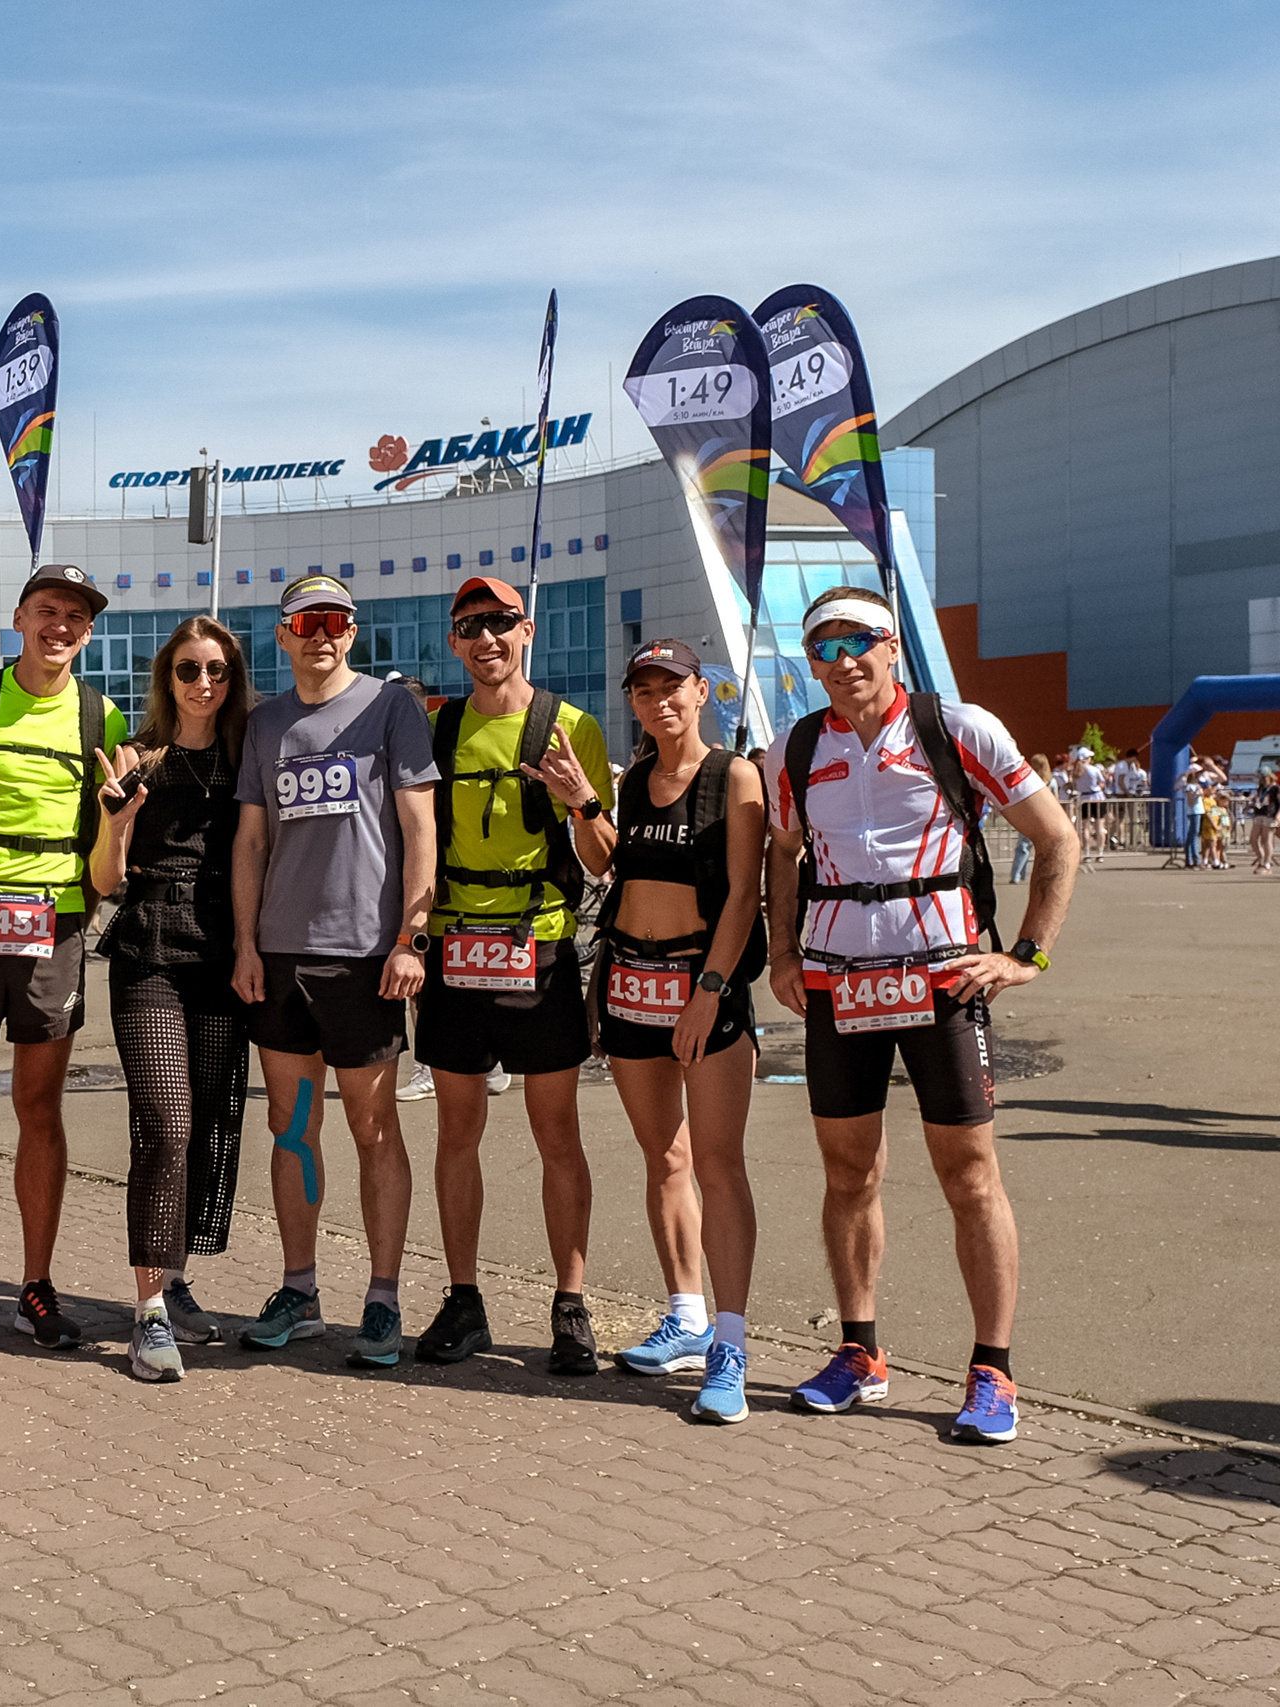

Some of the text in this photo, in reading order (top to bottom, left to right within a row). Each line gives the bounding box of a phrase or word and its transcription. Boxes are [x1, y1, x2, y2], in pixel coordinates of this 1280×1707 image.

[664, 319, 709, 338] Быстрее
[770, 327, 801, 349] Ветра
[682, 336, 715, 355] Ветра
[6, 353, 40, 393] 1:39
[770, 352, 825, 403] 1:49
[668, 371, 733, 409] 1:49
[776, 389, 825, 415] 5:10 мин/км
[673, 408, 725, 422] 5:10 мин/км
[403, 413, 594, 471] АБАКАН
[108, 459, 346, 489] СПОРТОМПЛЕКС
[276, 764, 352, 805] 999
[446, 940, 532, 970] 1425
[610, 971, 685, 1007] 1311
[835, 973, 927, 1011] 1460
